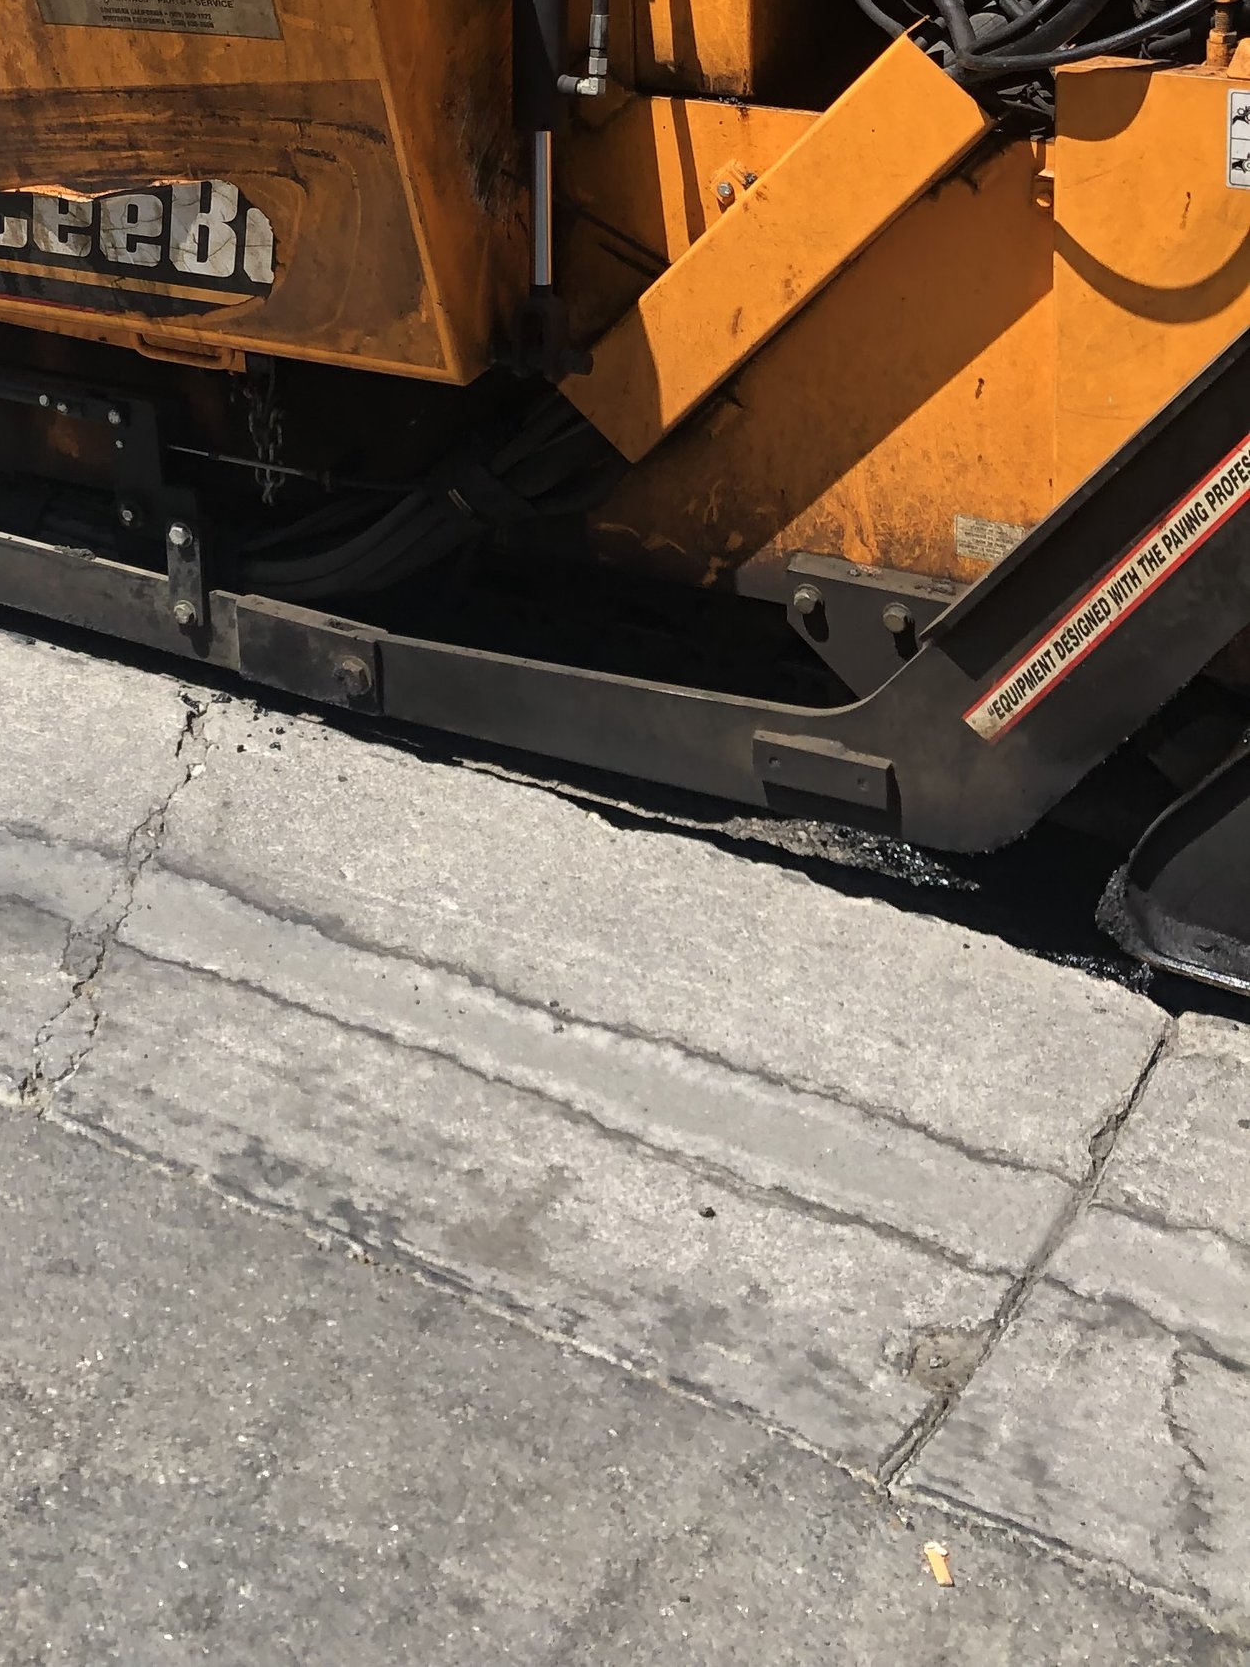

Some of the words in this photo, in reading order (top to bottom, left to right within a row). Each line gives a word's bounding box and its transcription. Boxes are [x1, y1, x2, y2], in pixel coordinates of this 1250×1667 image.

[1054, 596, 1111, 661] DESIGNED
[1108, 567, 1142, 606] WITH
[1137, 543, 1167, 578] THE
[1161, 501, 1209, 554] PAVING
[1204, 450, 1250, 512] PROFES
